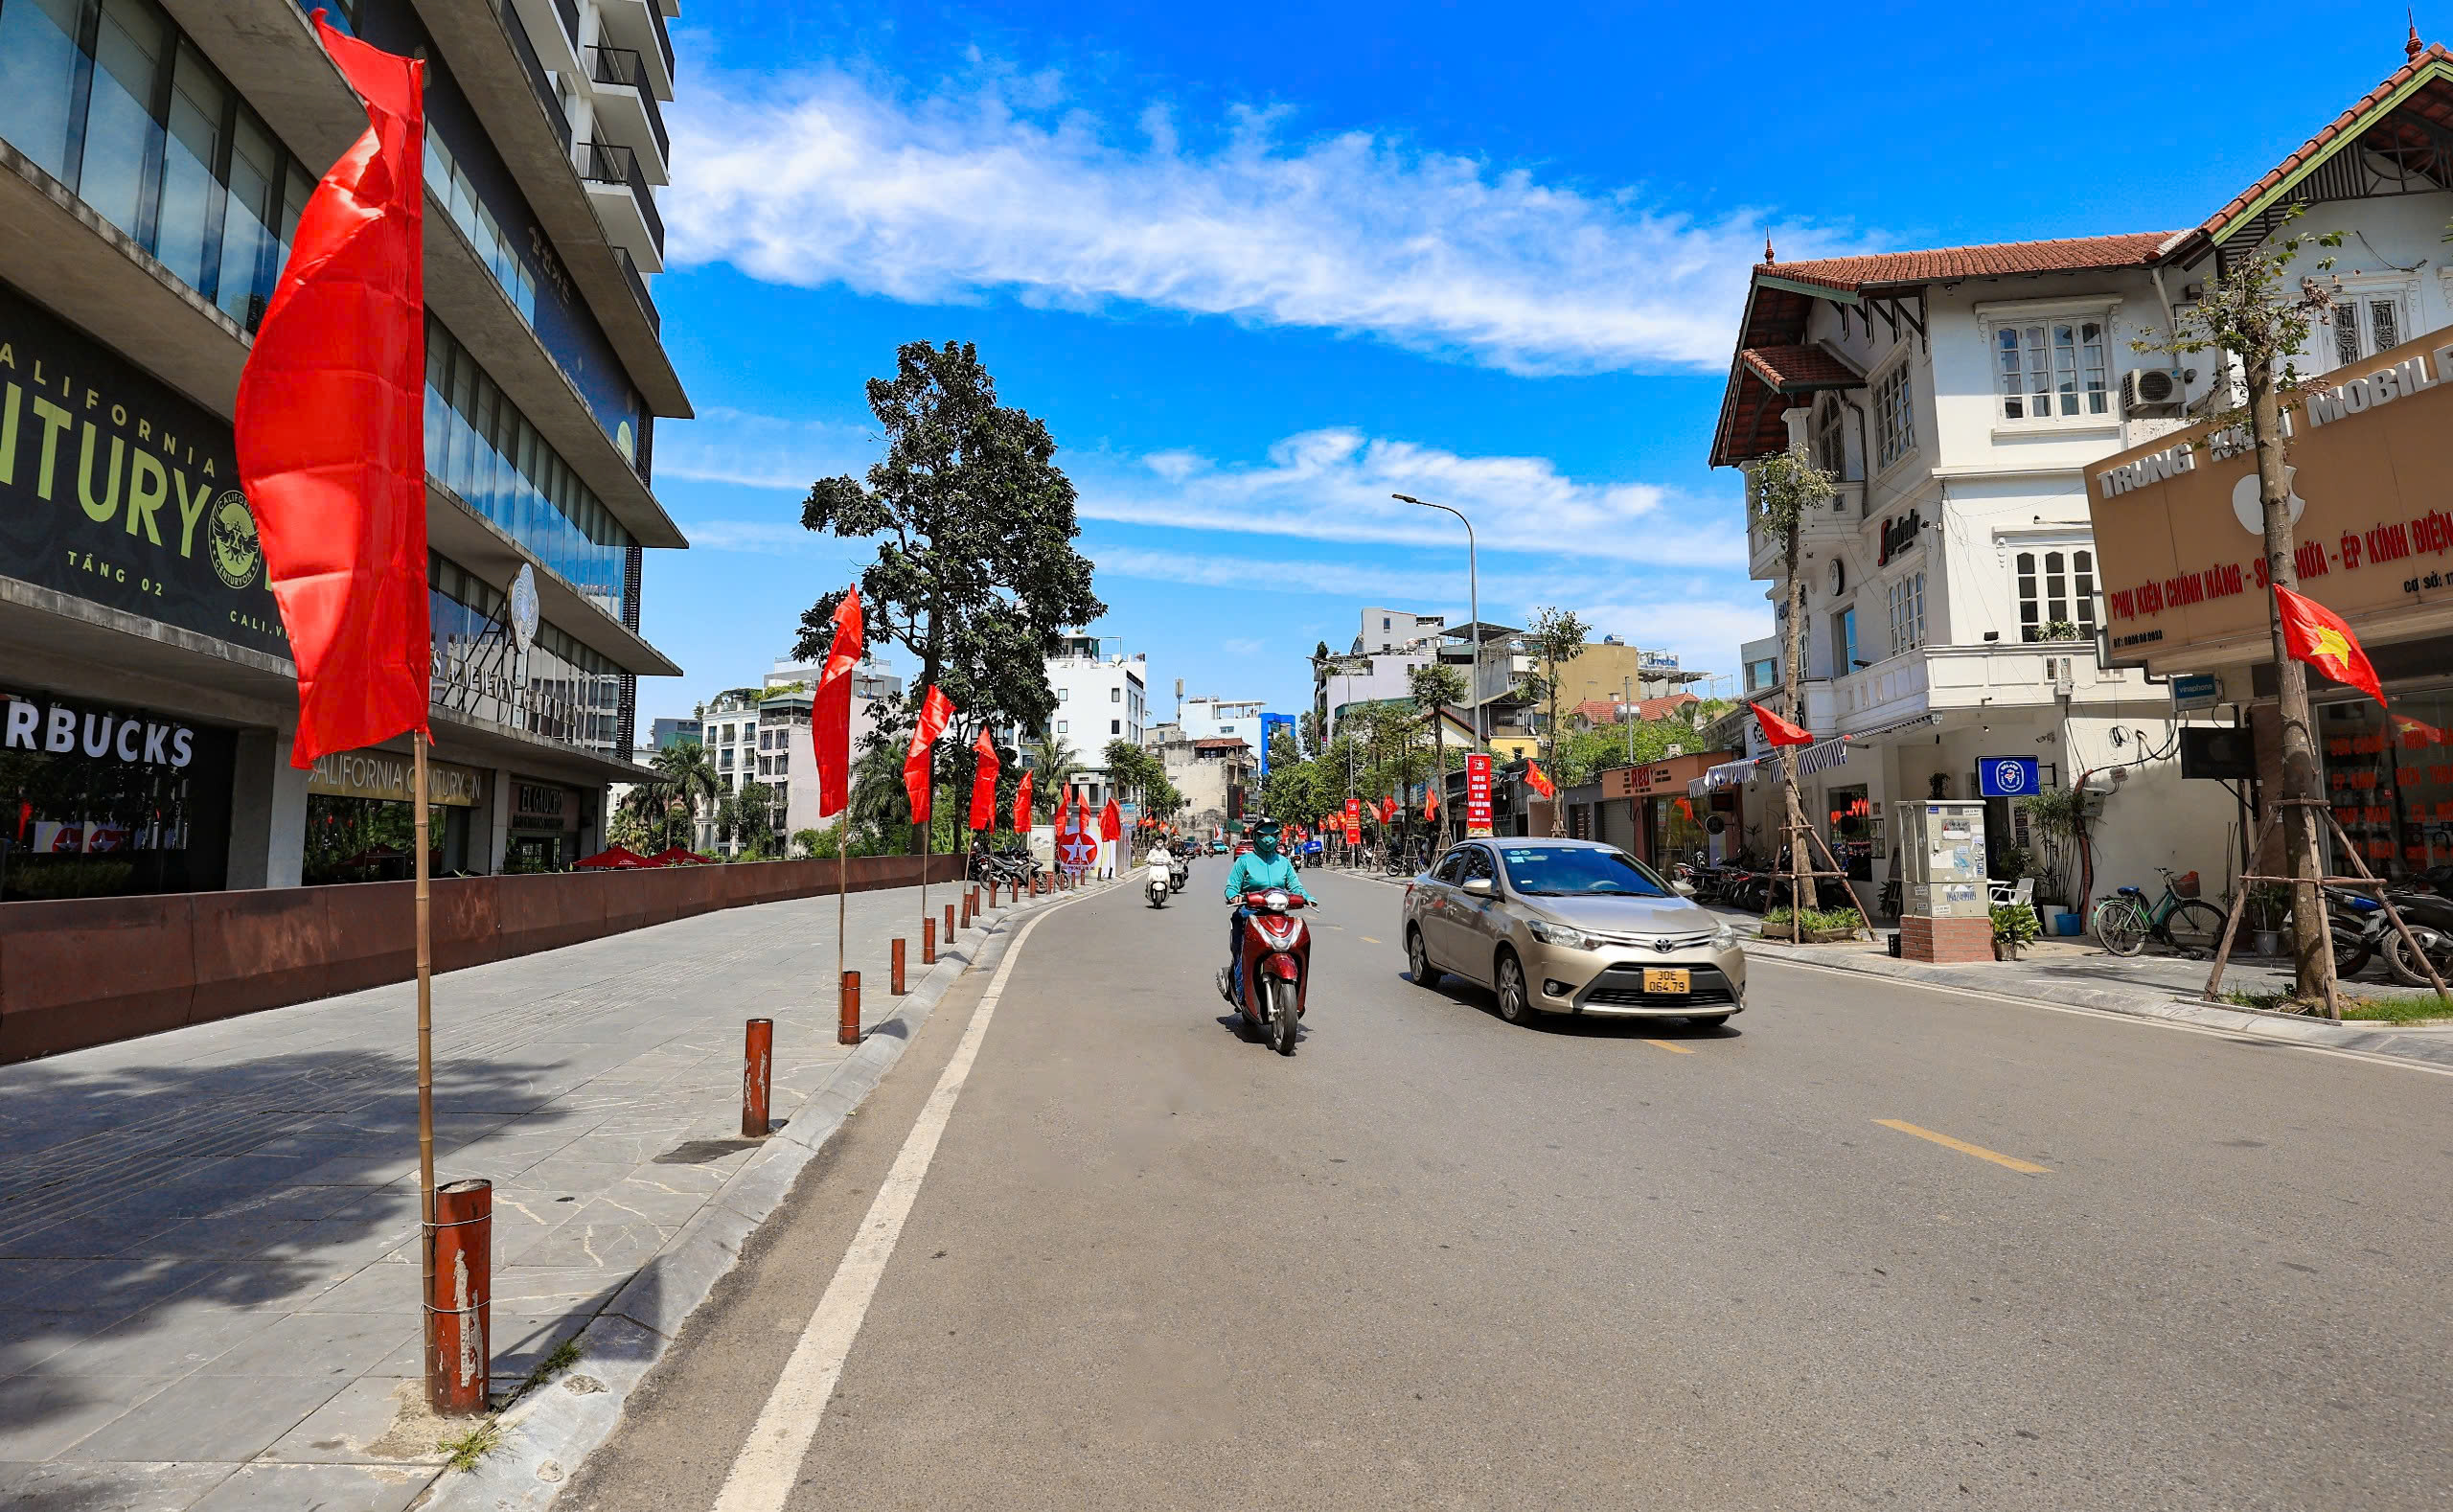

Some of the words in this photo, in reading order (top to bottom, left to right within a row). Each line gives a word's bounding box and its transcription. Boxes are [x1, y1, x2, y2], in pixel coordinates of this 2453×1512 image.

[2097, 443, 2196, 498] TRUNG
[68, 553, 125, 583] TẦNG
[141, 578, 163, 596] 02
[215, 559, 252, 586] CENTURYON
[2111, 589, 2136, 621] PHỤ
[2136, 580, 2165, 617] KIỆN
[2166, 571, 2205, 607] CHÍNH
[2341, 530, 2362, 570] ÉP
[2366, 522, 2412, 564] KÍNH
[2412, 509, 2453, 557] ĐIỆN
[2178, 683, 2213, 694] vinaphone
[5, 700, 195, 767] RBUCKS
[1649, 981, 1685, 993] 064.79
[1658, 970, 1677, 980] 30E
